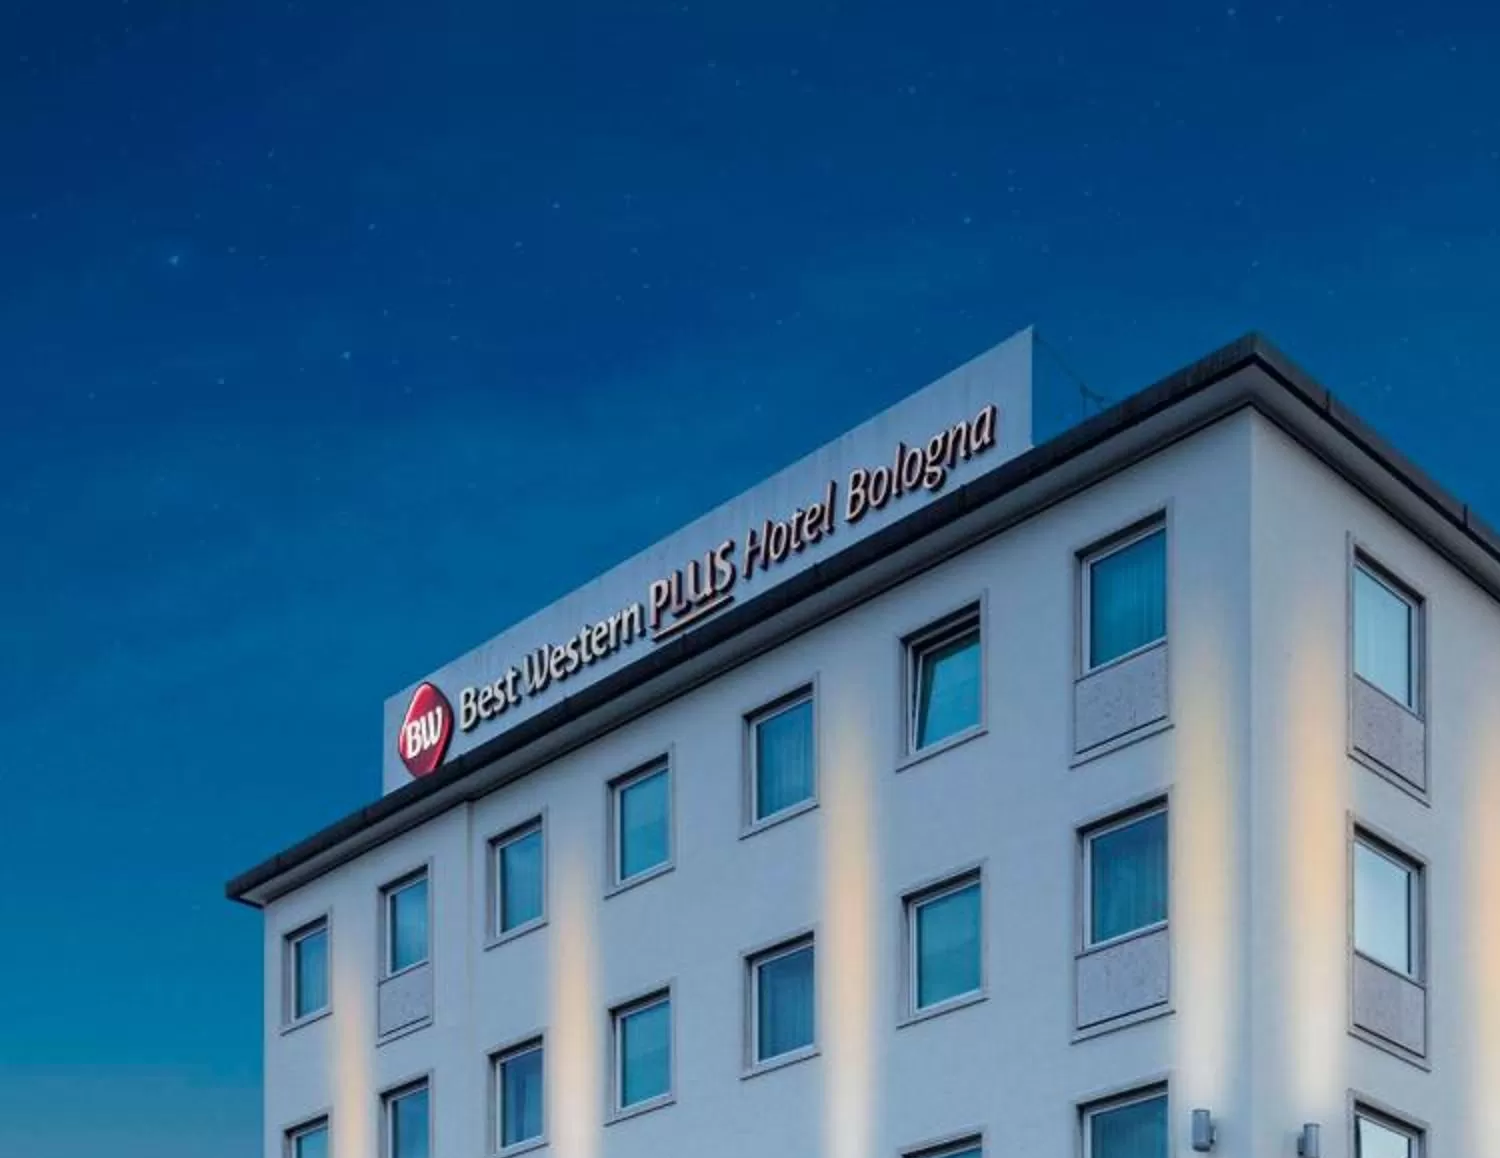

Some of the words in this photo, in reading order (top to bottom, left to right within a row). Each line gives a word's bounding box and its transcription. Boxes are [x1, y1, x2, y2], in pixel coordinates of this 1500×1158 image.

[459, 667, 519, 732] Best
[523, 602, 641, 694] Western
[650, 539, 736, 630] PLUS
[743, 480, 837, 578] Hotel
[845, 404, 998, 522] Bologna
[405, 706, 442, 760] BW
